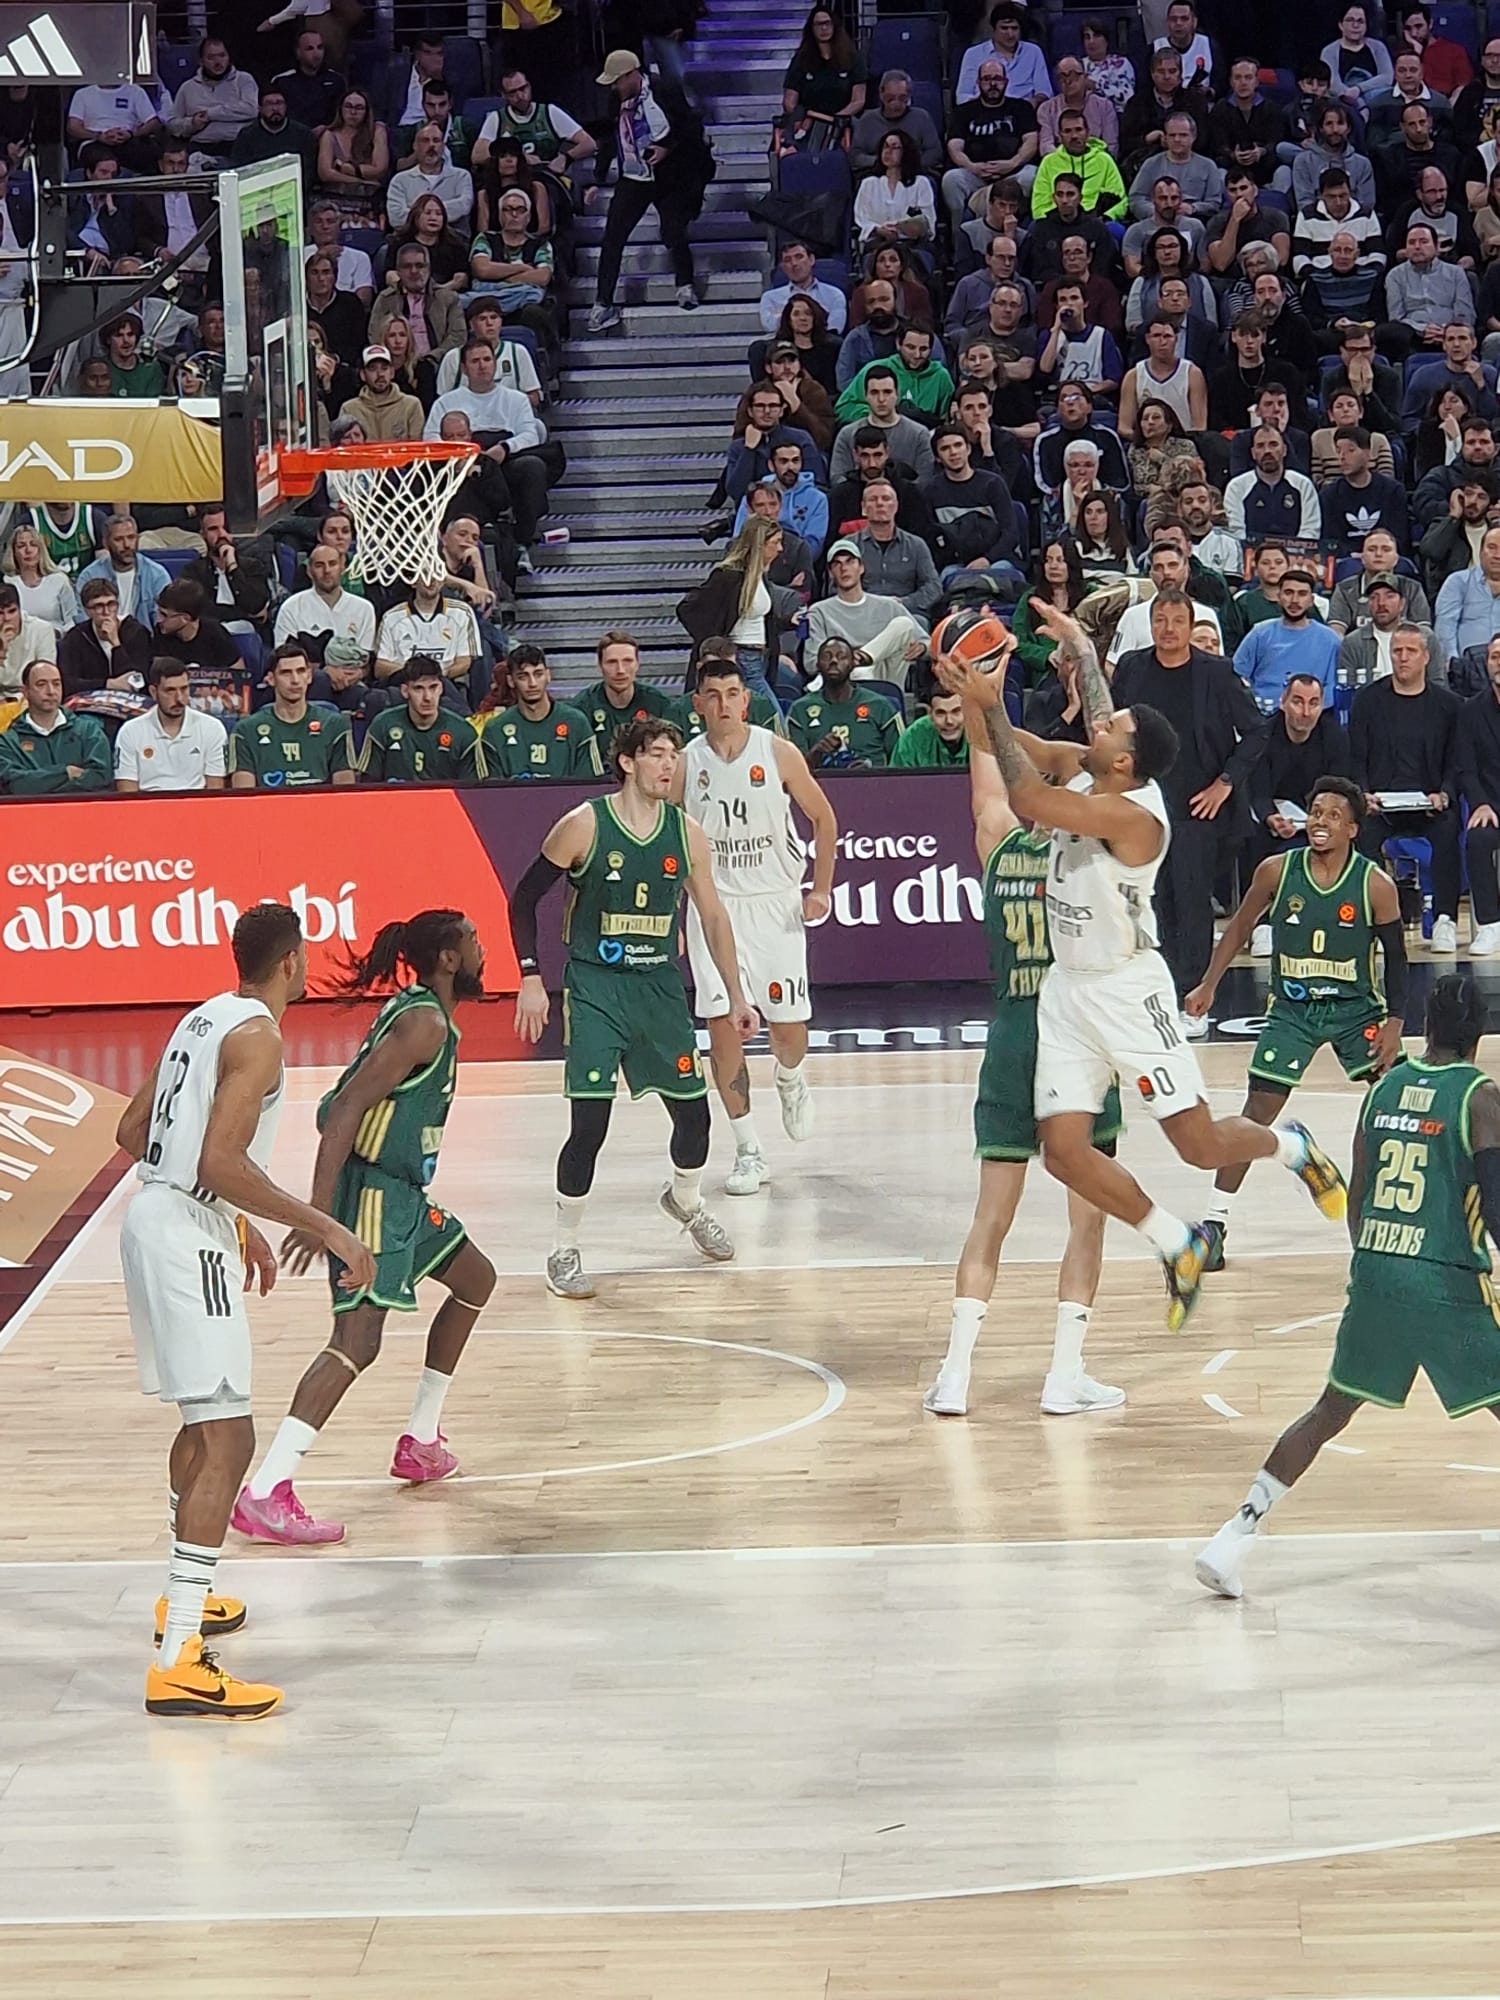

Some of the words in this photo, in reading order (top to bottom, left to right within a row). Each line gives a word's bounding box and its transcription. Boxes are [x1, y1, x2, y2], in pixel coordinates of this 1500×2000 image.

[0, 440, 134, 481] AD
[530, 744, 547, 764] 20
[718, 797, 748, 828] 14
[635, 882, 649, 908] 6
[3, 891, 140, 951] abu
[1002, 901, 1050, 961] 41
[1312, 929, 1326, 954] 0
[1373, 1138, 1429, 1214] 25
